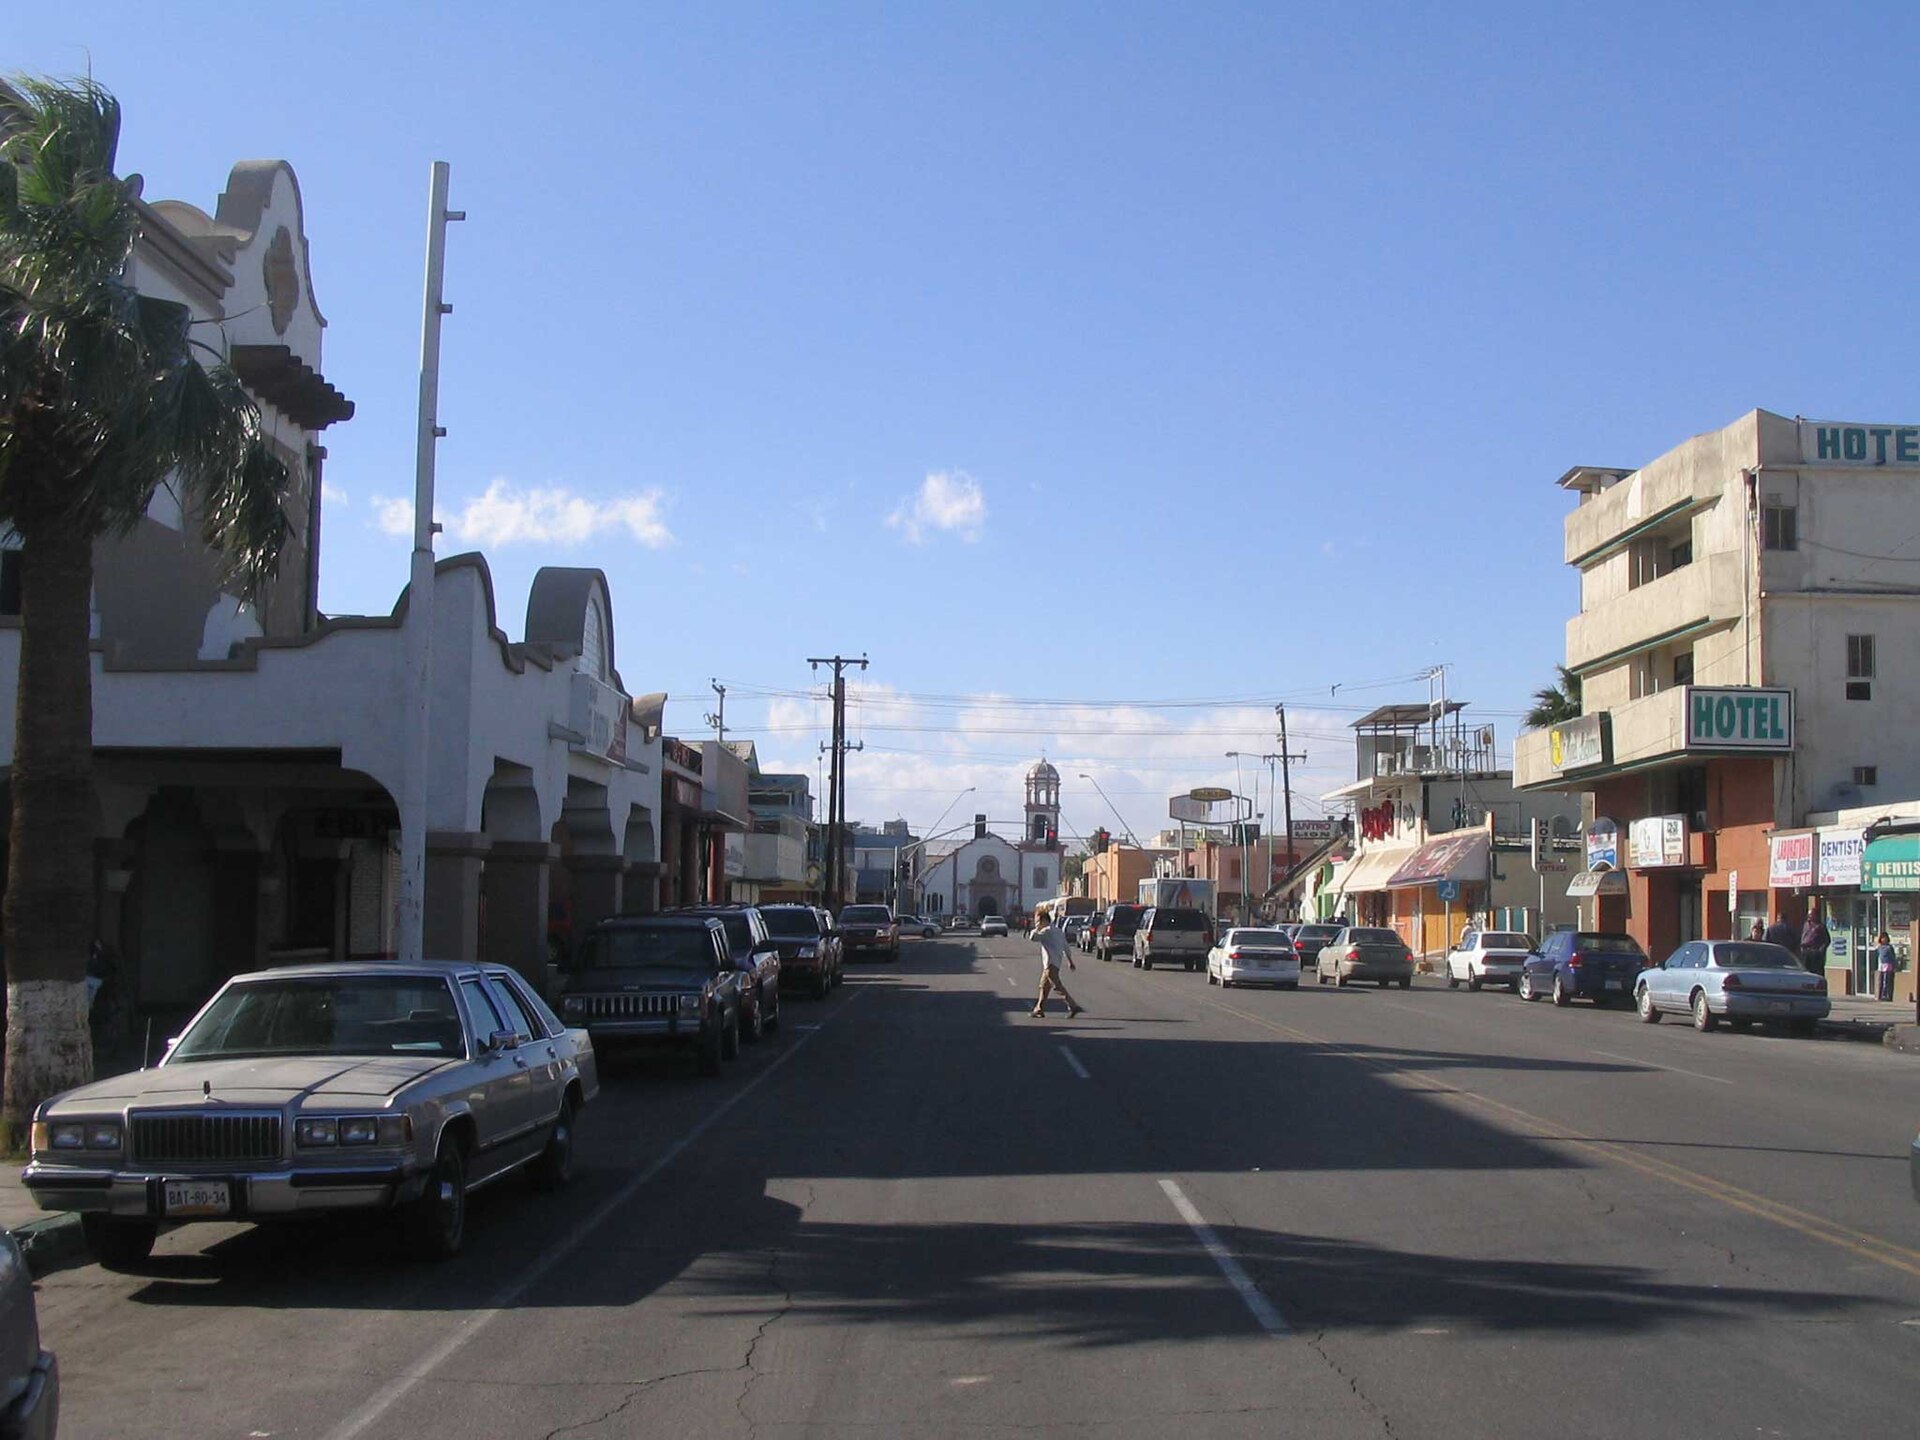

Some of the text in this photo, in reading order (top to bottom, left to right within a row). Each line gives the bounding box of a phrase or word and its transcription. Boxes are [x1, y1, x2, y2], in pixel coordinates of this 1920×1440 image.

[1694, 695, 1784, 739] HOTEL
[1539, 819, 1549, 862] HOTEL
[1821, 839, 1864, 857] DENTISTA
